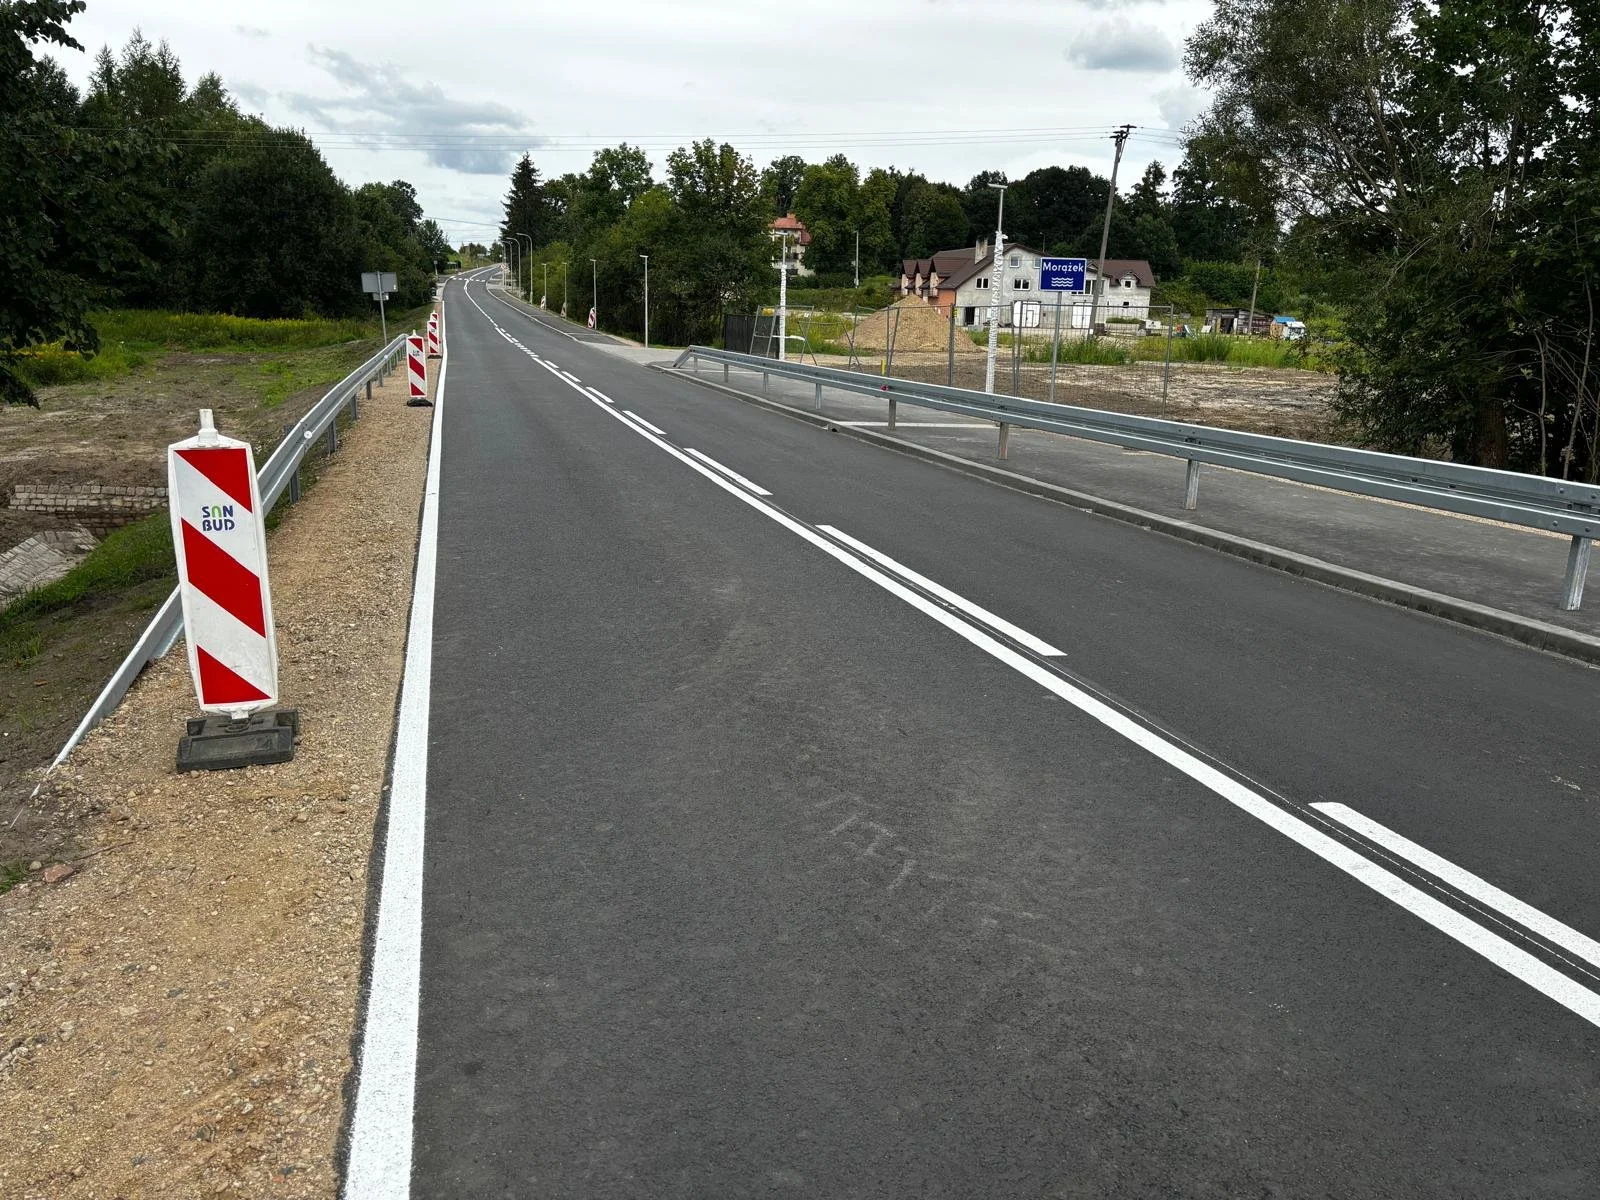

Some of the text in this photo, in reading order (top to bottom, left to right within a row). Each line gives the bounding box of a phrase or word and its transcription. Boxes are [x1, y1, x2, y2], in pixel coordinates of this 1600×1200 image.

[1043, 262, 1084, 274] Morążek
[202, 505, 233, 518] SAN
[202, 519, 235, 531] BUD
